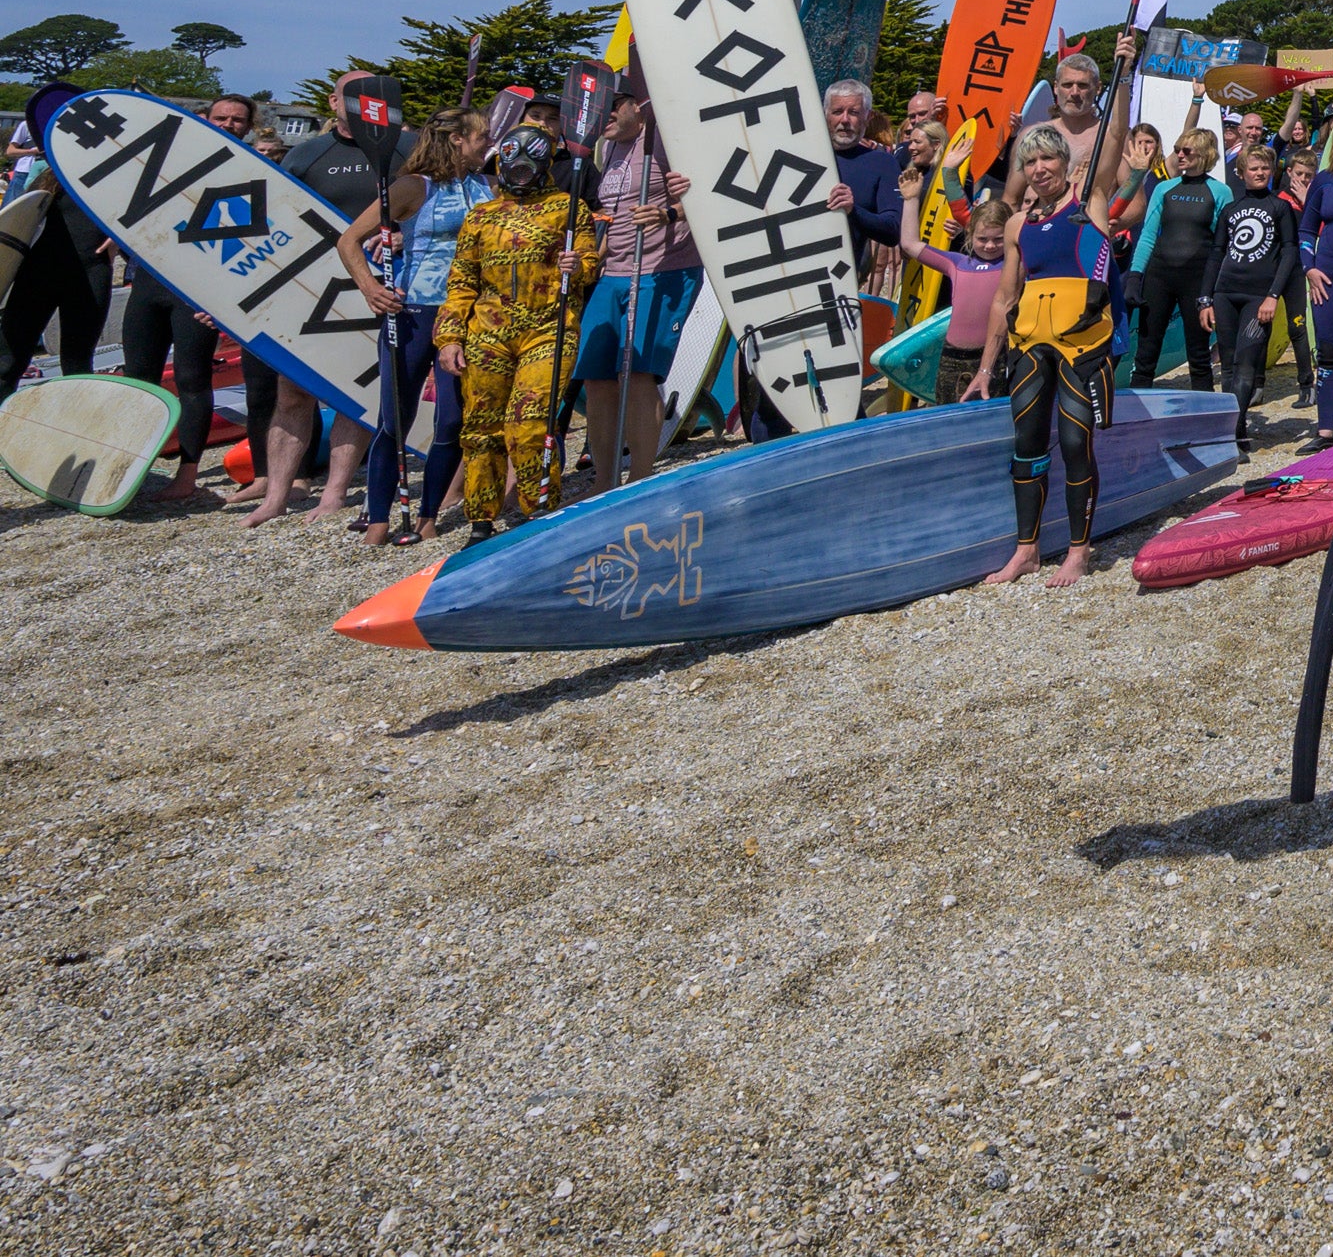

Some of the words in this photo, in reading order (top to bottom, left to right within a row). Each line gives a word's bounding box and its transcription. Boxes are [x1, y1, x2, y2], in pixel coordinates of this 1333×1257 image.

[1181, 38, 1243, 60] VOTE
[695, 30, 805, 134] OF
[957, 30, 1013, 129] STOP
[364, 99, 384, 122] bp
[328, 164, 370, 174] O'NEI
[1171, 194, 1205, 204] O'NEILL
[1229, 208, 1272, 224] SURFERS
[229, 230, 293, 277] wwa
[1248, 226, 1274, 262] SEWAGE
[382, 246, 394, 289] BLACK
[1248, 542, 1280, 556] FANATIC
